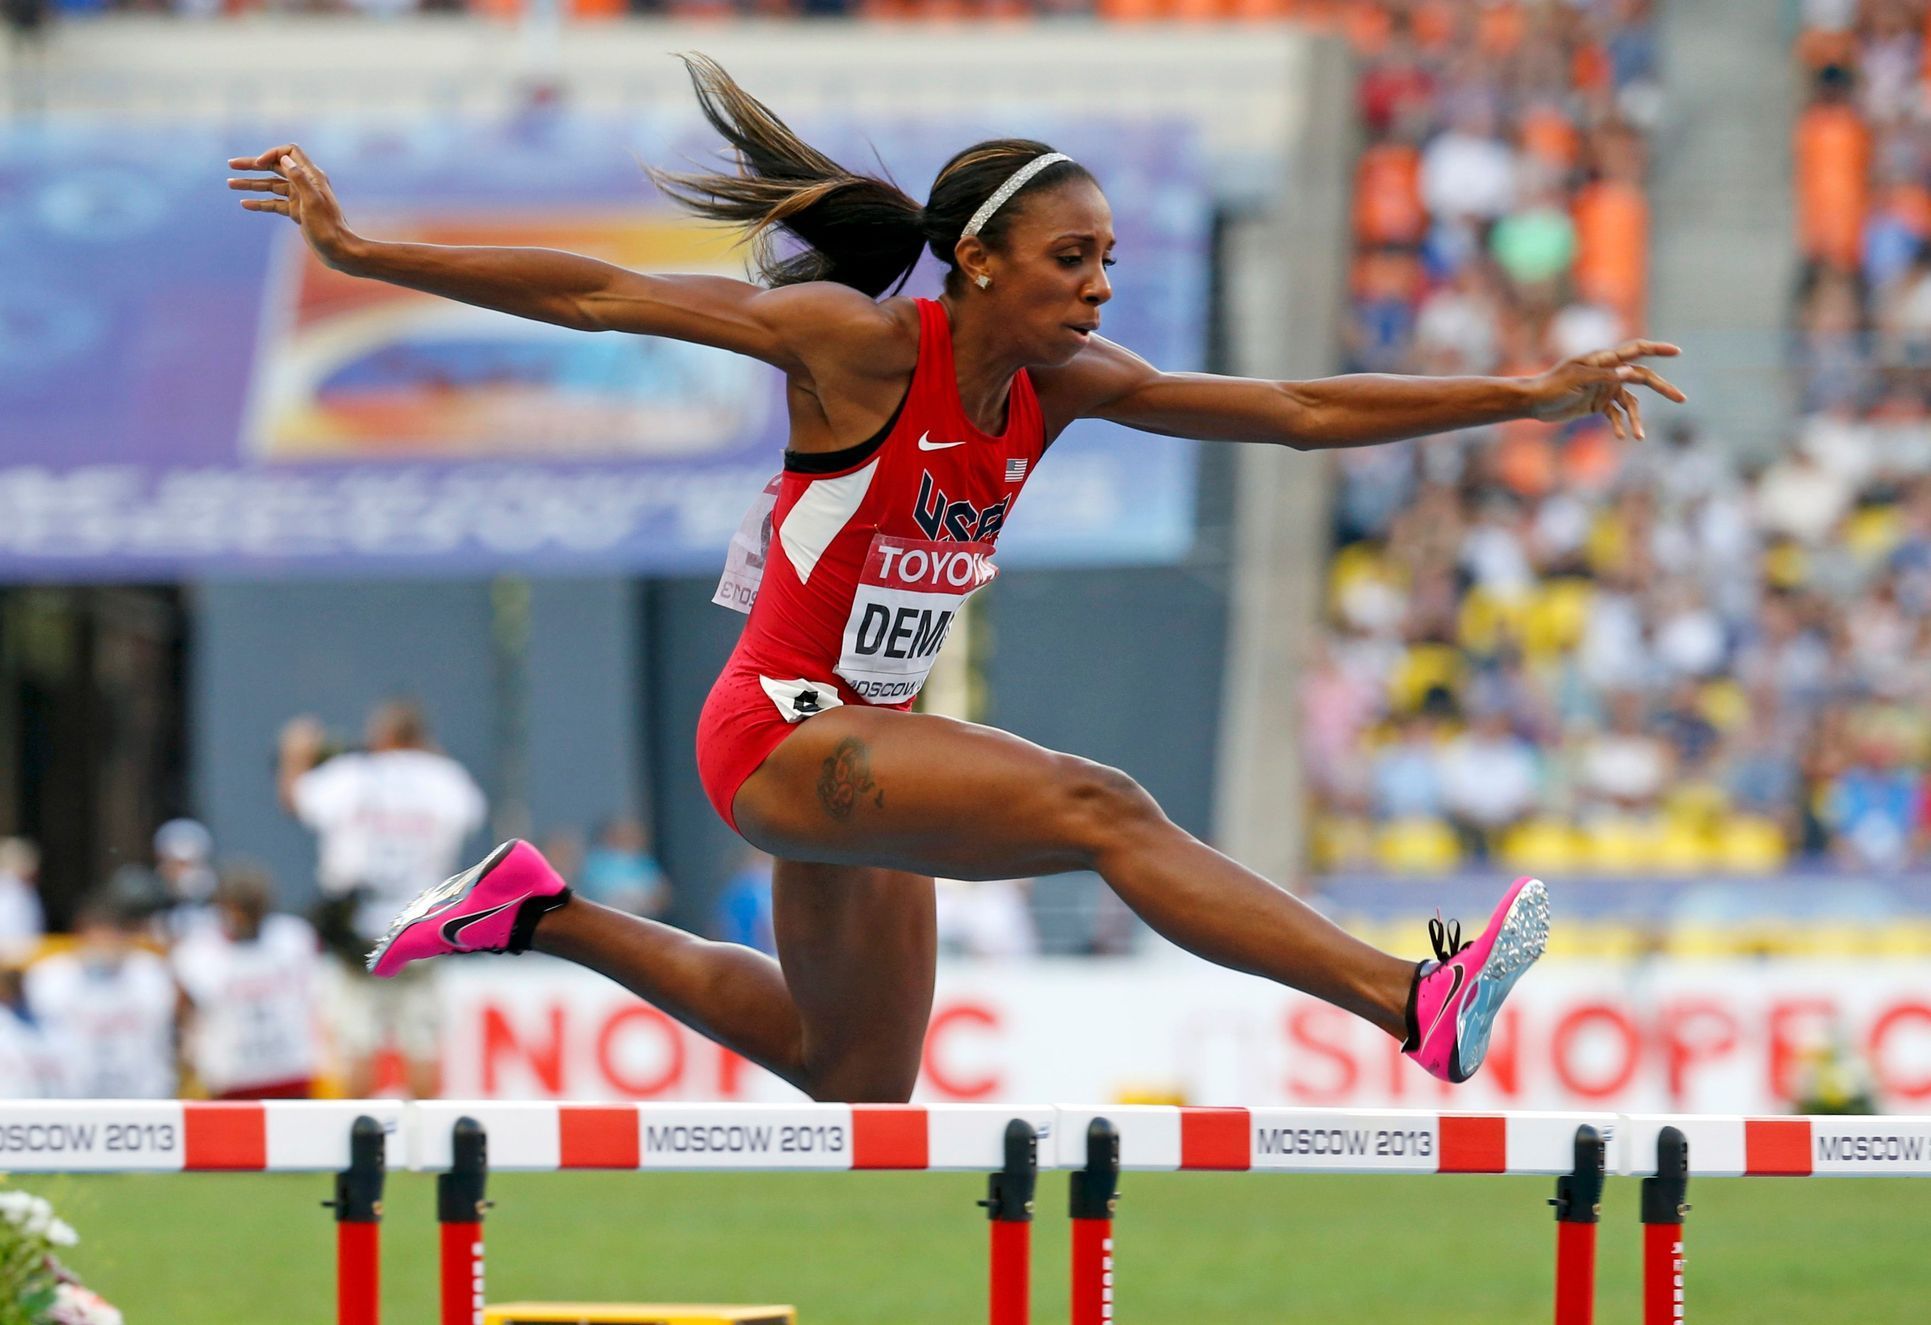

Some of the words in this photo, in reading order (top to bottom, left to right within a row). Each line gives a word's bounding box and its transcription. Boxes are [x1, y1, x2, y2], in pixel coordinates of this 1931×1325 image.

[855, 603, 955, 659] DEM
[106, 1124, 174, 1151] 2013
[647, 1126, 773, 1152] MOSCOW
[780, 1126, 844, 1152] 2013
[1258, 1129, 1370, 1155] MOSCOW
[1376, 1130, 1432, 1156] 2013
[1818, 1136, 1925, 1160] MOSCOW
